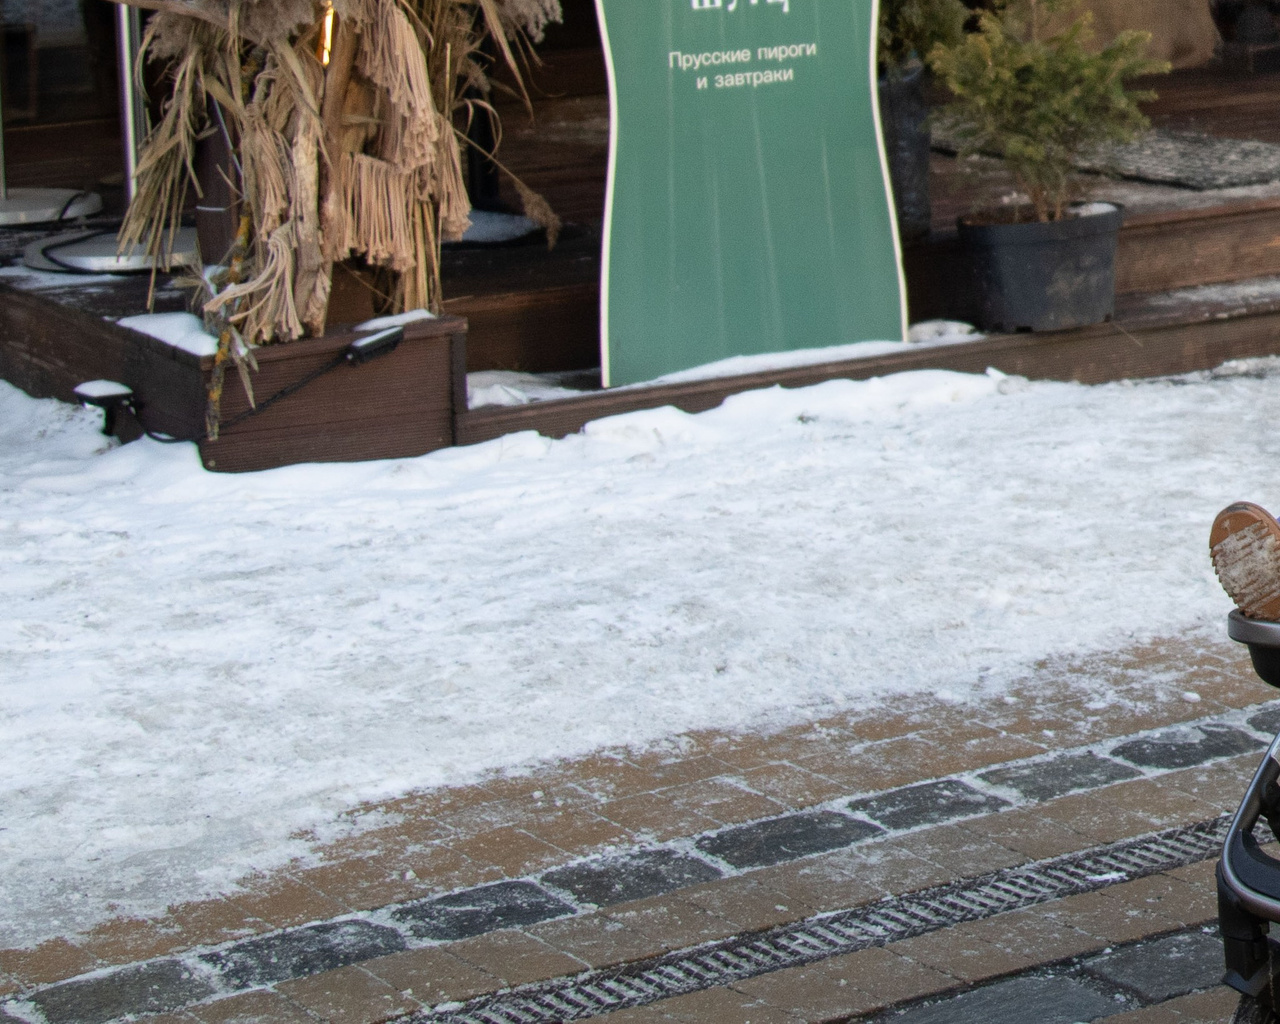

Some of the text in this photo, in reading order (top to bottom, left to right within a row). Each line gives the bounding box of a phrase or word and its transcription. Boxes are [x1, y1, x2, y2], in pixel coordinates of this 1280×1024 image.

[669, 42, 817, 70] Прусские пироги
[697, 68, 793, 89] и завтраки
